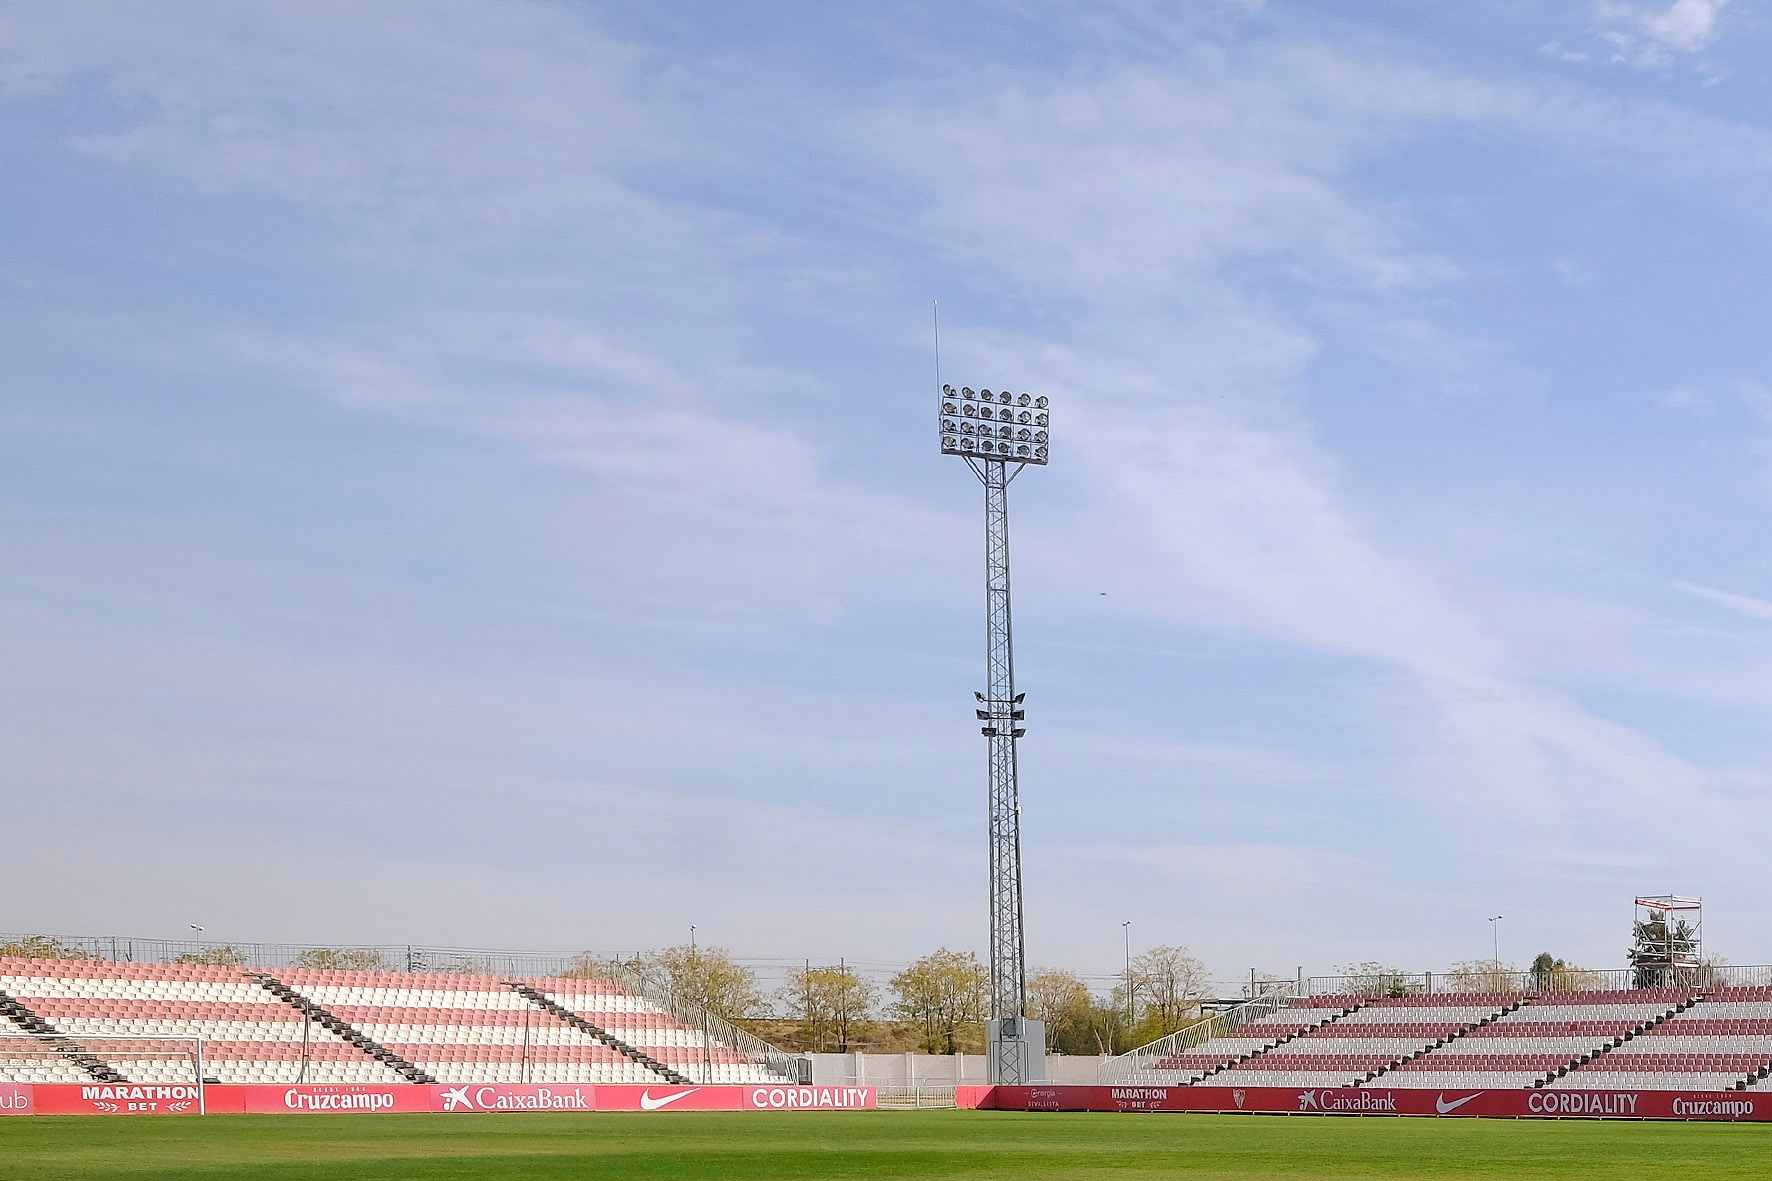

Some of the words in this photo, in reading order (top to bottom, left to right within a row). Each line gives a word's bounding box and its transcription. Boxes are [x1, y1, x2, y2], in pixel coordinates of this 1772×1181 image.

[82, 1086, 199, 1100] MARATHON
[284, 1088, 395, 1112] Cruzcampo
[477, 1087, 588, 1109] CaixaBank
[752, 1088, 869, 1108] CORDIALITY
[1111, 1088, 1167, 1099] MARATHON
[1320, 1090, 1397, 1111] CaixaBank
[1528, 1092, 1639, 1113] CORDIALITY
[128, 1102, 158, 1111] BET
[1672, 1097, 1754, 1118] Cruzcampo
